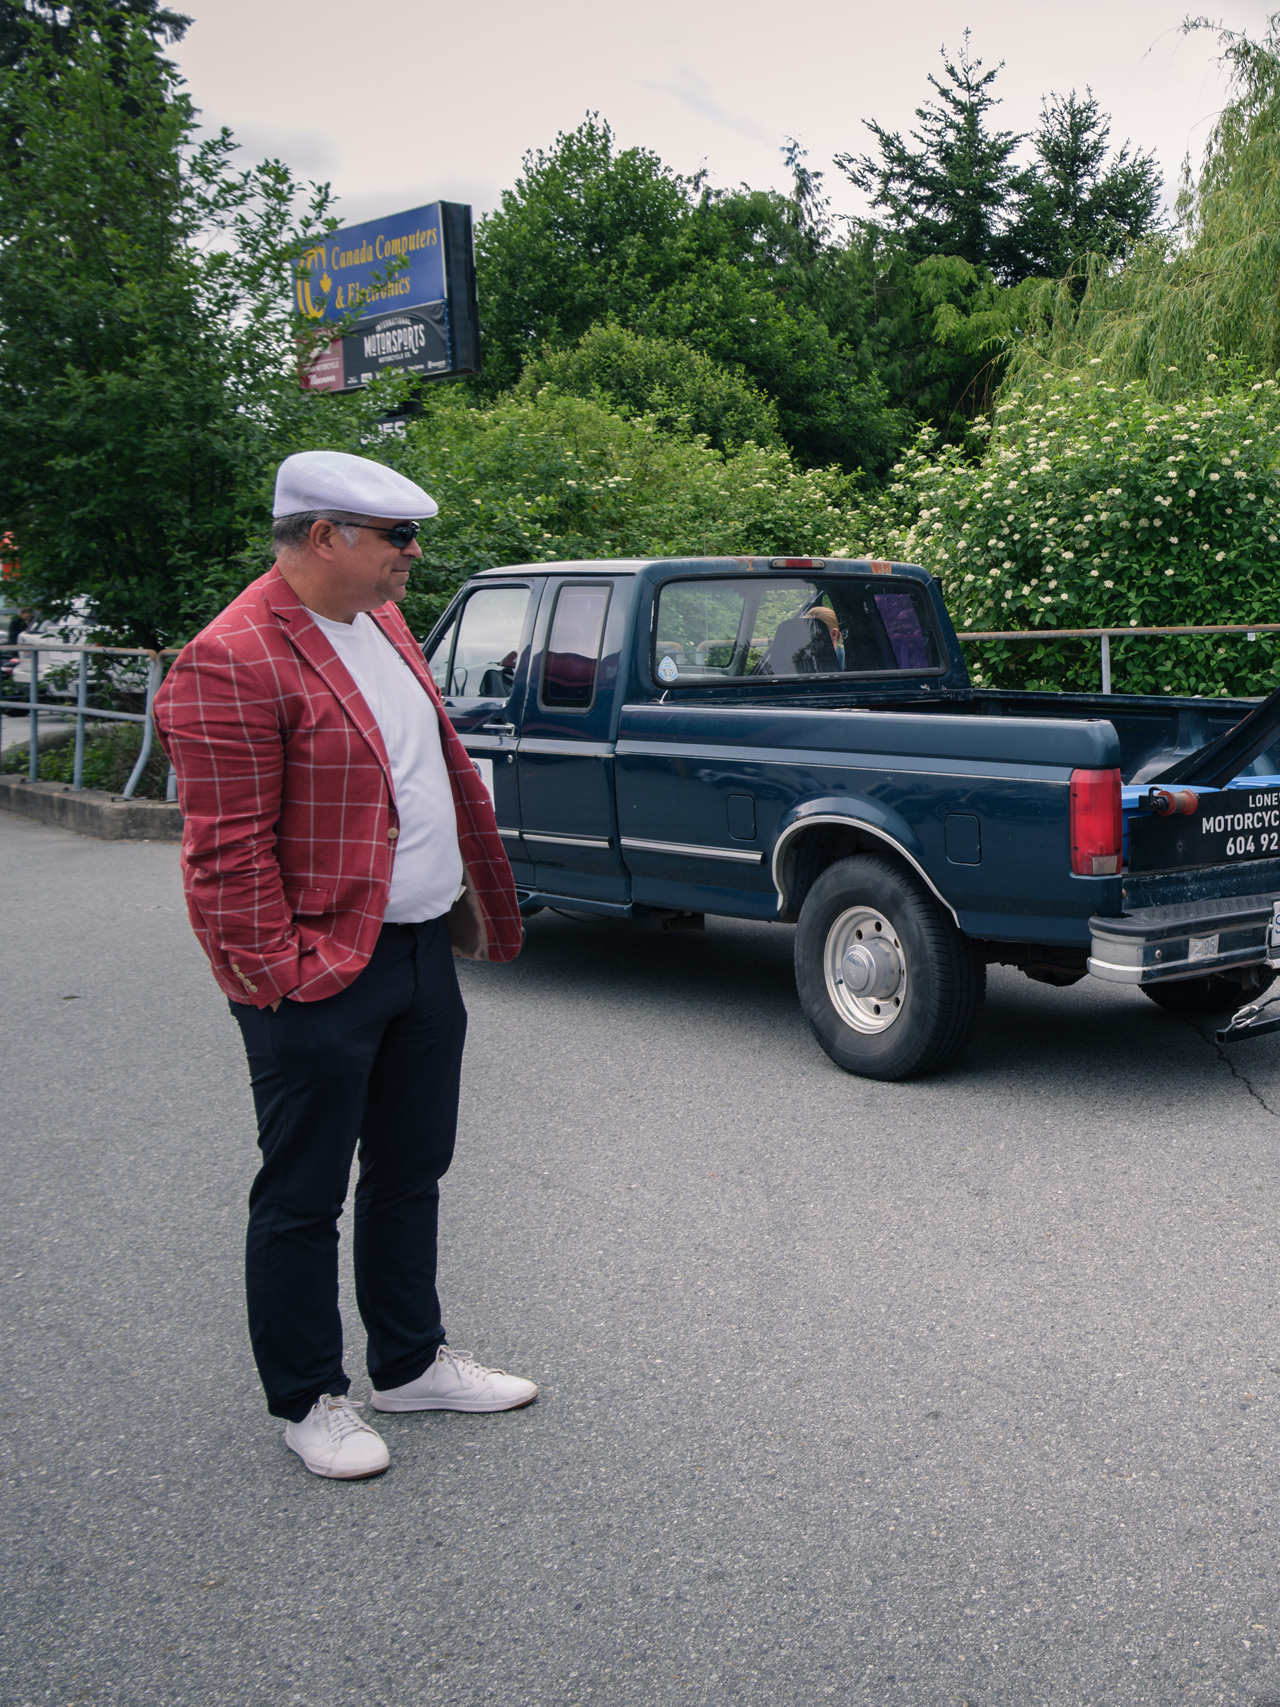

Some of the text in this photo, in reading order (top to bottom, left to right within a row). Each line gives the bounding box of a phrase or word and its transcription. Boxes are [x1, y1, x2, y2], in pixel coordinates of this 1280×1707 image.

[331, 228, 437, 270] Canada Computers
[335, 286, 345, 309] &
[364, 323, 426, 358] MOTORSPORTS
[1226, 835, 1255, 856] 604
